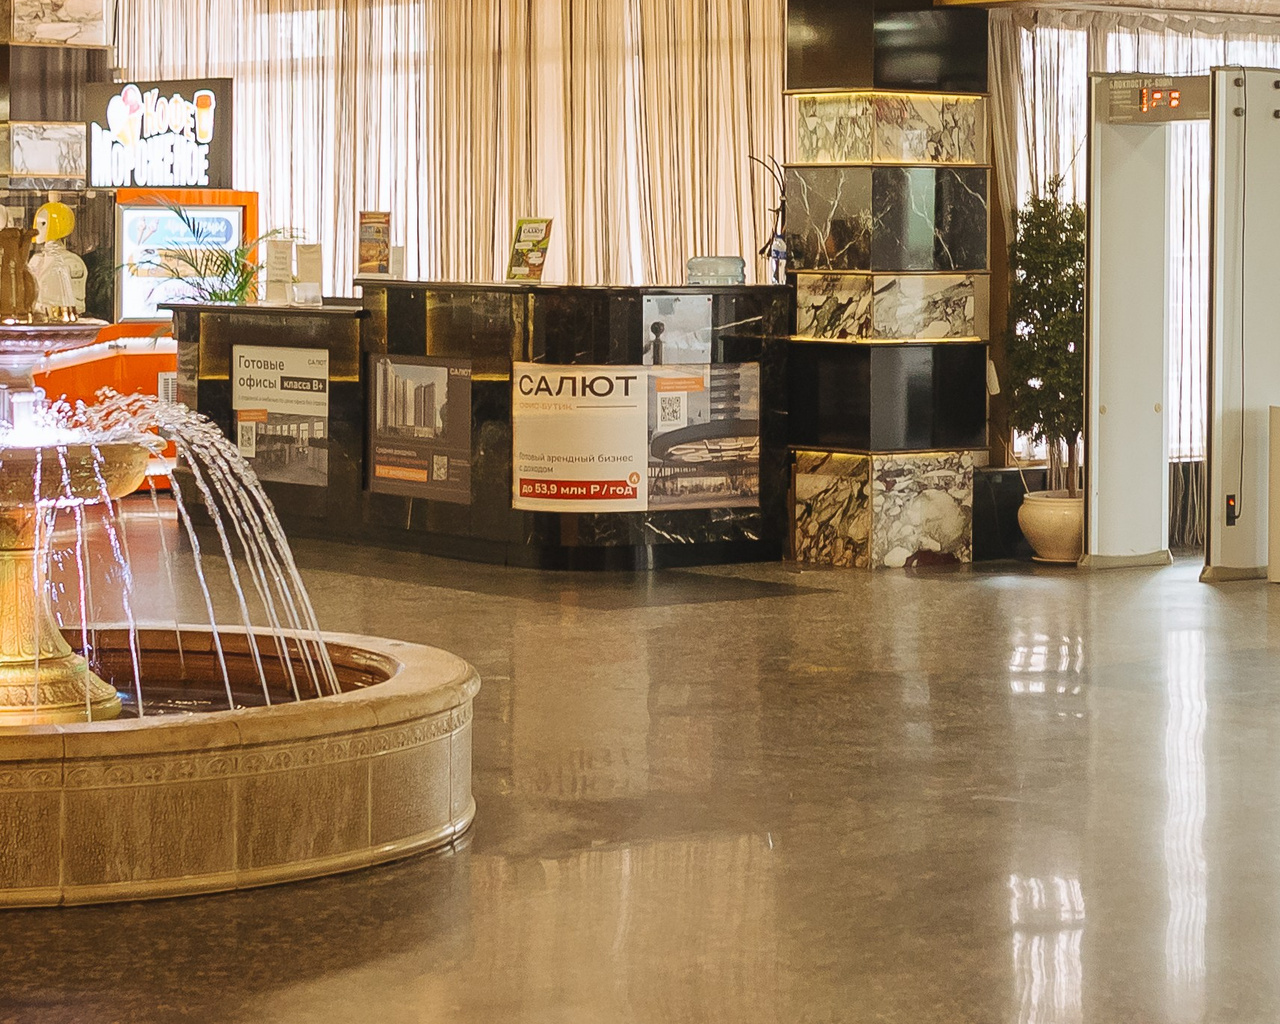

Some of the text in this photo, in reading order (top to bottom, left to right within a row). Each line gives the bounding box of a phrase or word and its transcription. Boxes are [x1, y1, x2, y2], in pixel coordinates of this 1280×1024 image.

[238, 355, 285, 371] Готовые
[238, 374, 277, 390] офисы
[283, 380, 311, 390] класса
[519, 374, 638, 397] САЛЮТ
[546, 454, 595, 464] арендный
[597, 453, 634, 463] бизнес
[523, 465, 554, 474] доходом
[522, 484, 533, 494] до
[534, 483, 558, 496] 53,9
[560, 486, 587, 495] млн
